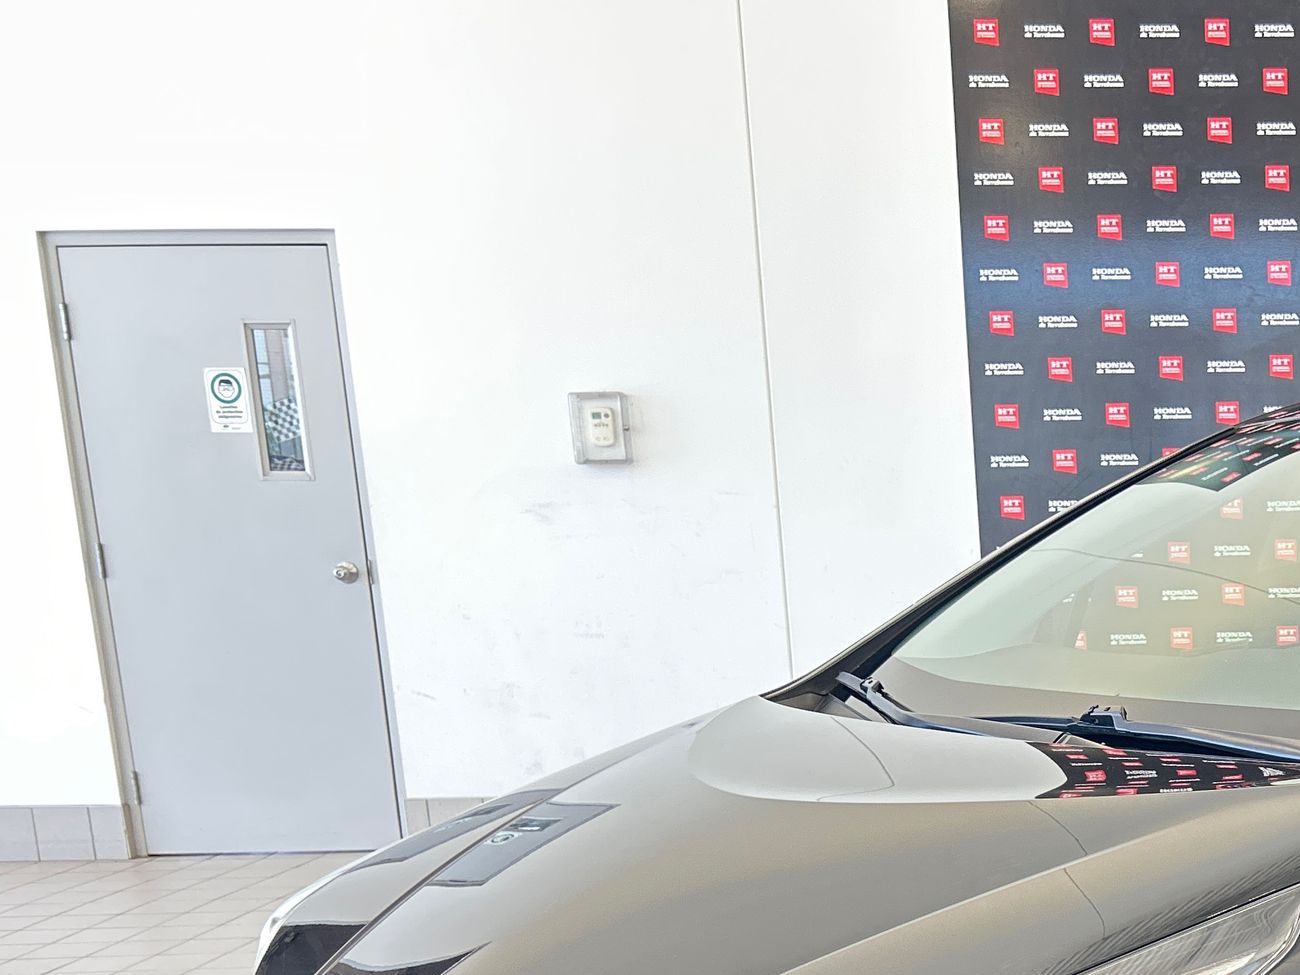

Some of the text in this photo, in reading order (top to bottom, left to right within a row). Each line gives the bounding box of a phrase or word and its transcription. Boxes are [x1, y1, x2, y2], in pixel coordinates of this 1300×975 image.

[1255, 24, 1294, 32] HONDA
[1199, 74, 1238, 82] HONDA
[1143, 123, 1182, 131] HONDA
[1257, 122, 1296, 130] HONDA
[1201, 171, 1240, 179] HONDA
[991, 455, 1029, 463] HONDA
